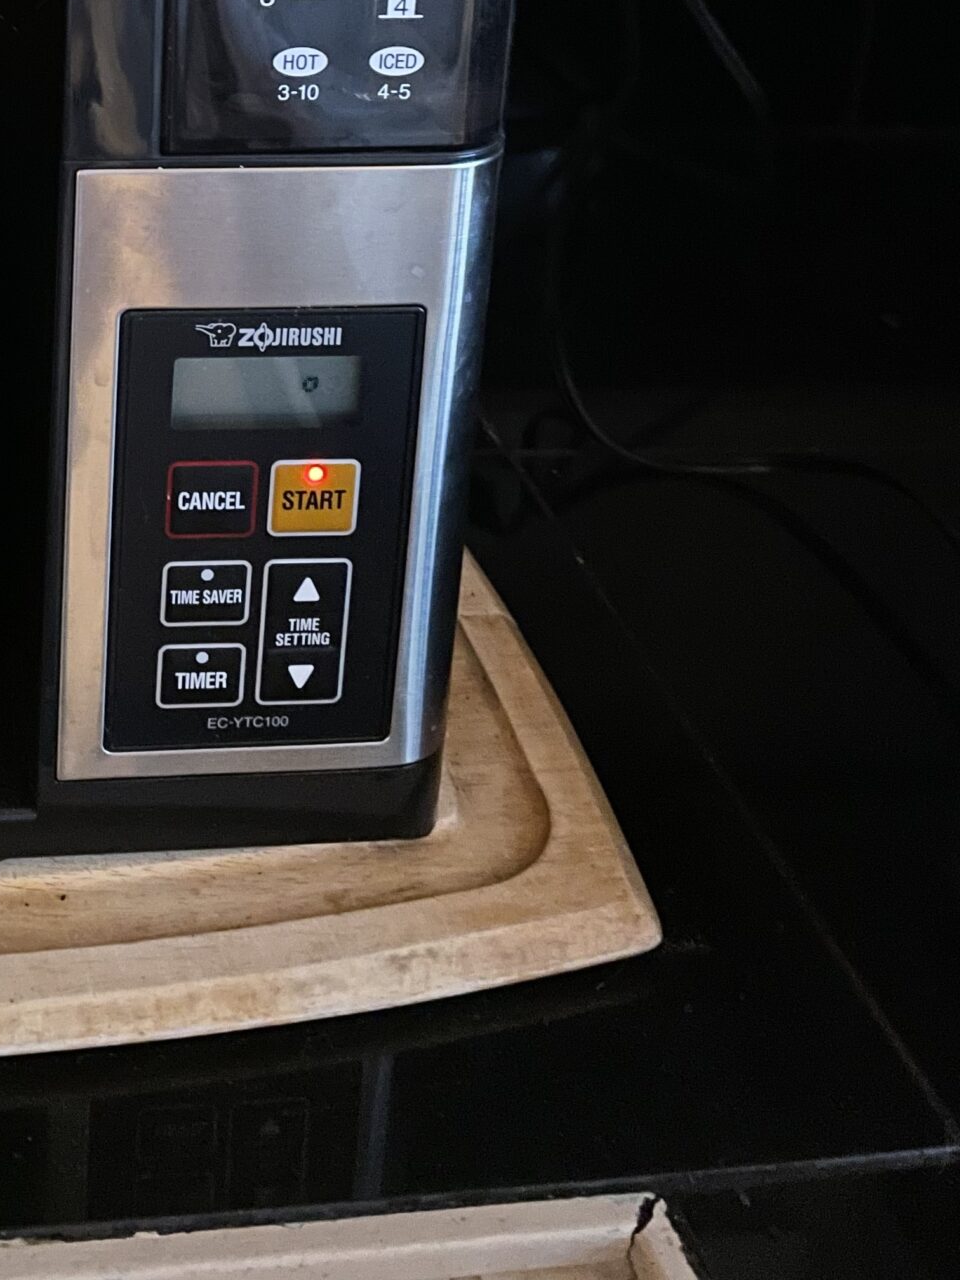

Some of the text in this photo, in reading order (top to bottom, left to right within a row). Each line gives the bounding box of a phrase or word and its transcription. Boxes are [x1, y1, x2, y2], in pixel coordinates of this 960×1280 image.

[282, 54, 320, 70] HOT
[378, 53, 417, 69] ICED
[277, 84, 320, 101] 3-10
[377, 83, 411, 100] 4-5
[238, 322, 342, 352] ZOJIRUSHI
[178, 491, 245, 510] CANCEL
[282, 489, 346, 510] START
[170, 589, 242, 605] TIME SAVER
[288, 618, 320, 631] TIME
[275, 632, 330, 646] SETTING
[175, 672, 227, 689] TIMER
[207, 716, 289, 729] EC-YTC100
